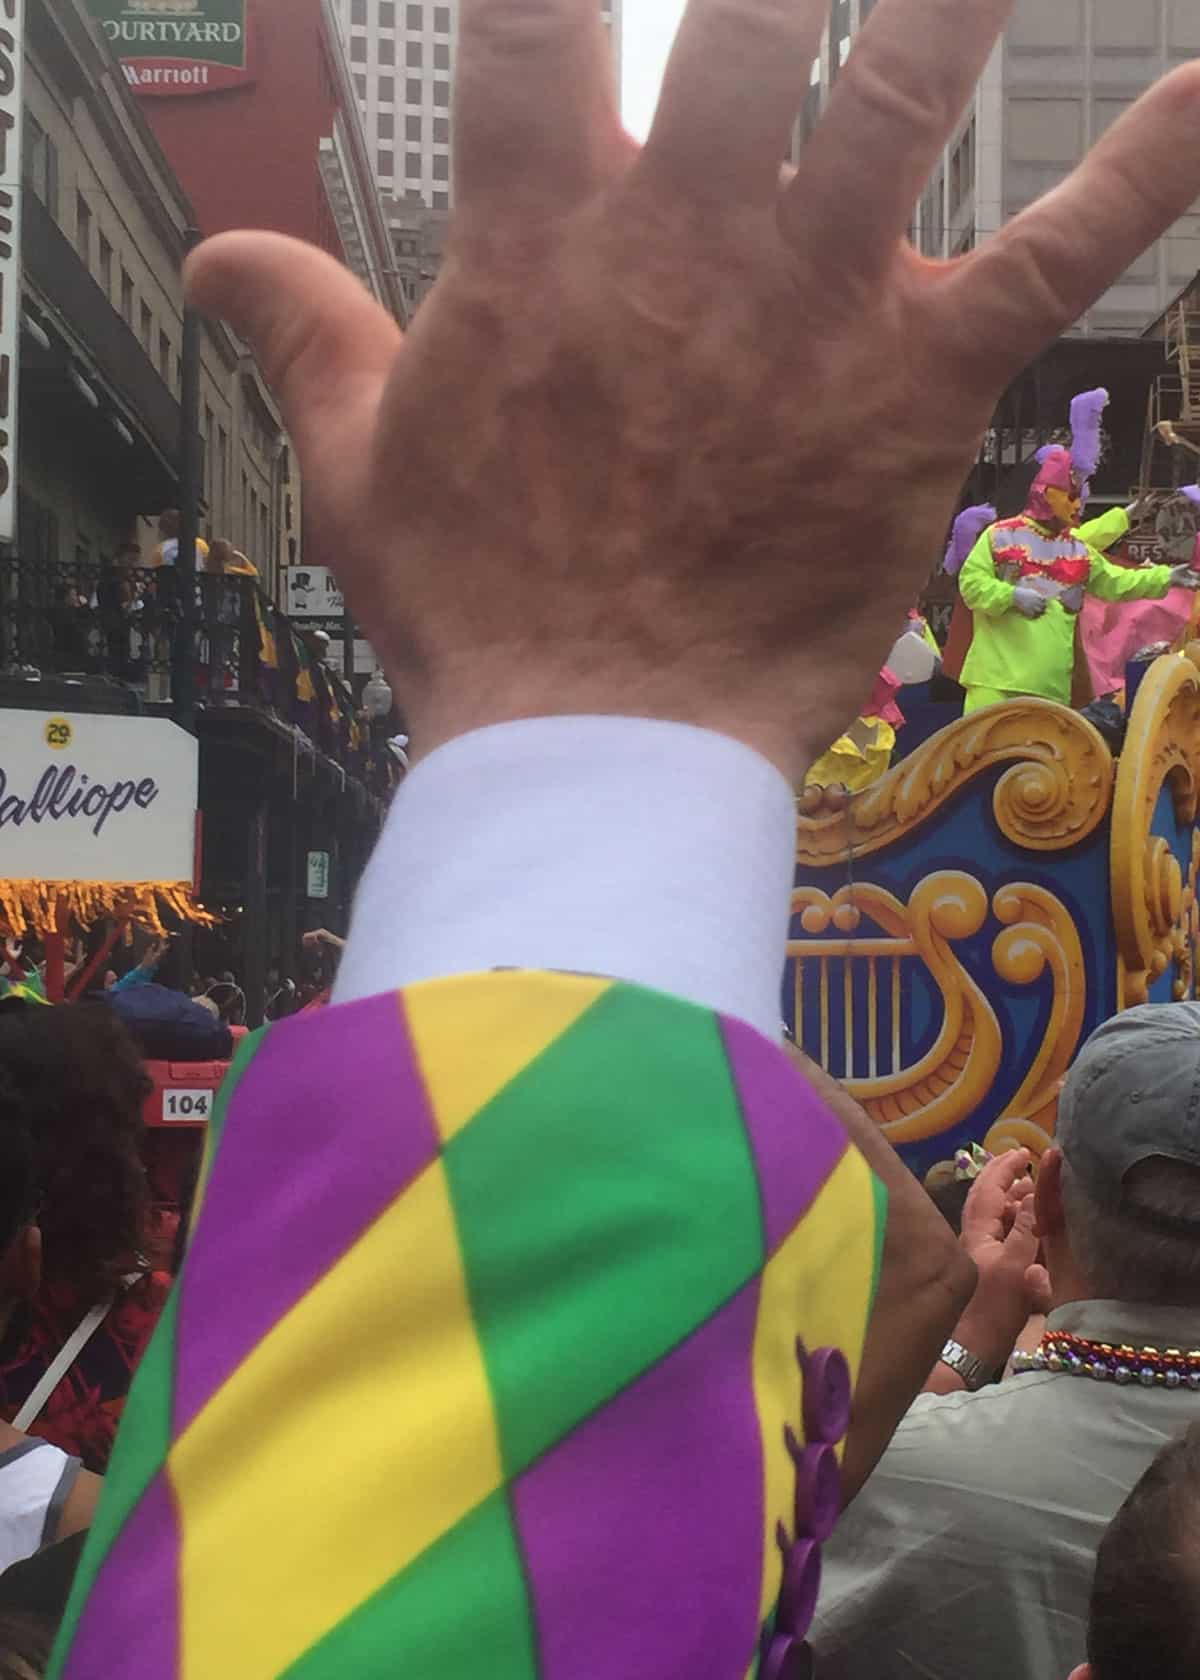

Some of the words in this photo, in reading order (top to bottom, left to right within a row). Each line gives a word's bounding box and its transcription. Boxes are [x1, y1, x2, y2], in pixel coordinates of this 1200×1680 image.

[103, 20, 241, 42] OURTYARD
[47, 723, 71, 744] 29
[0, 764, 159, 836] alliope
[167, 1095, 207, 1114] 104
